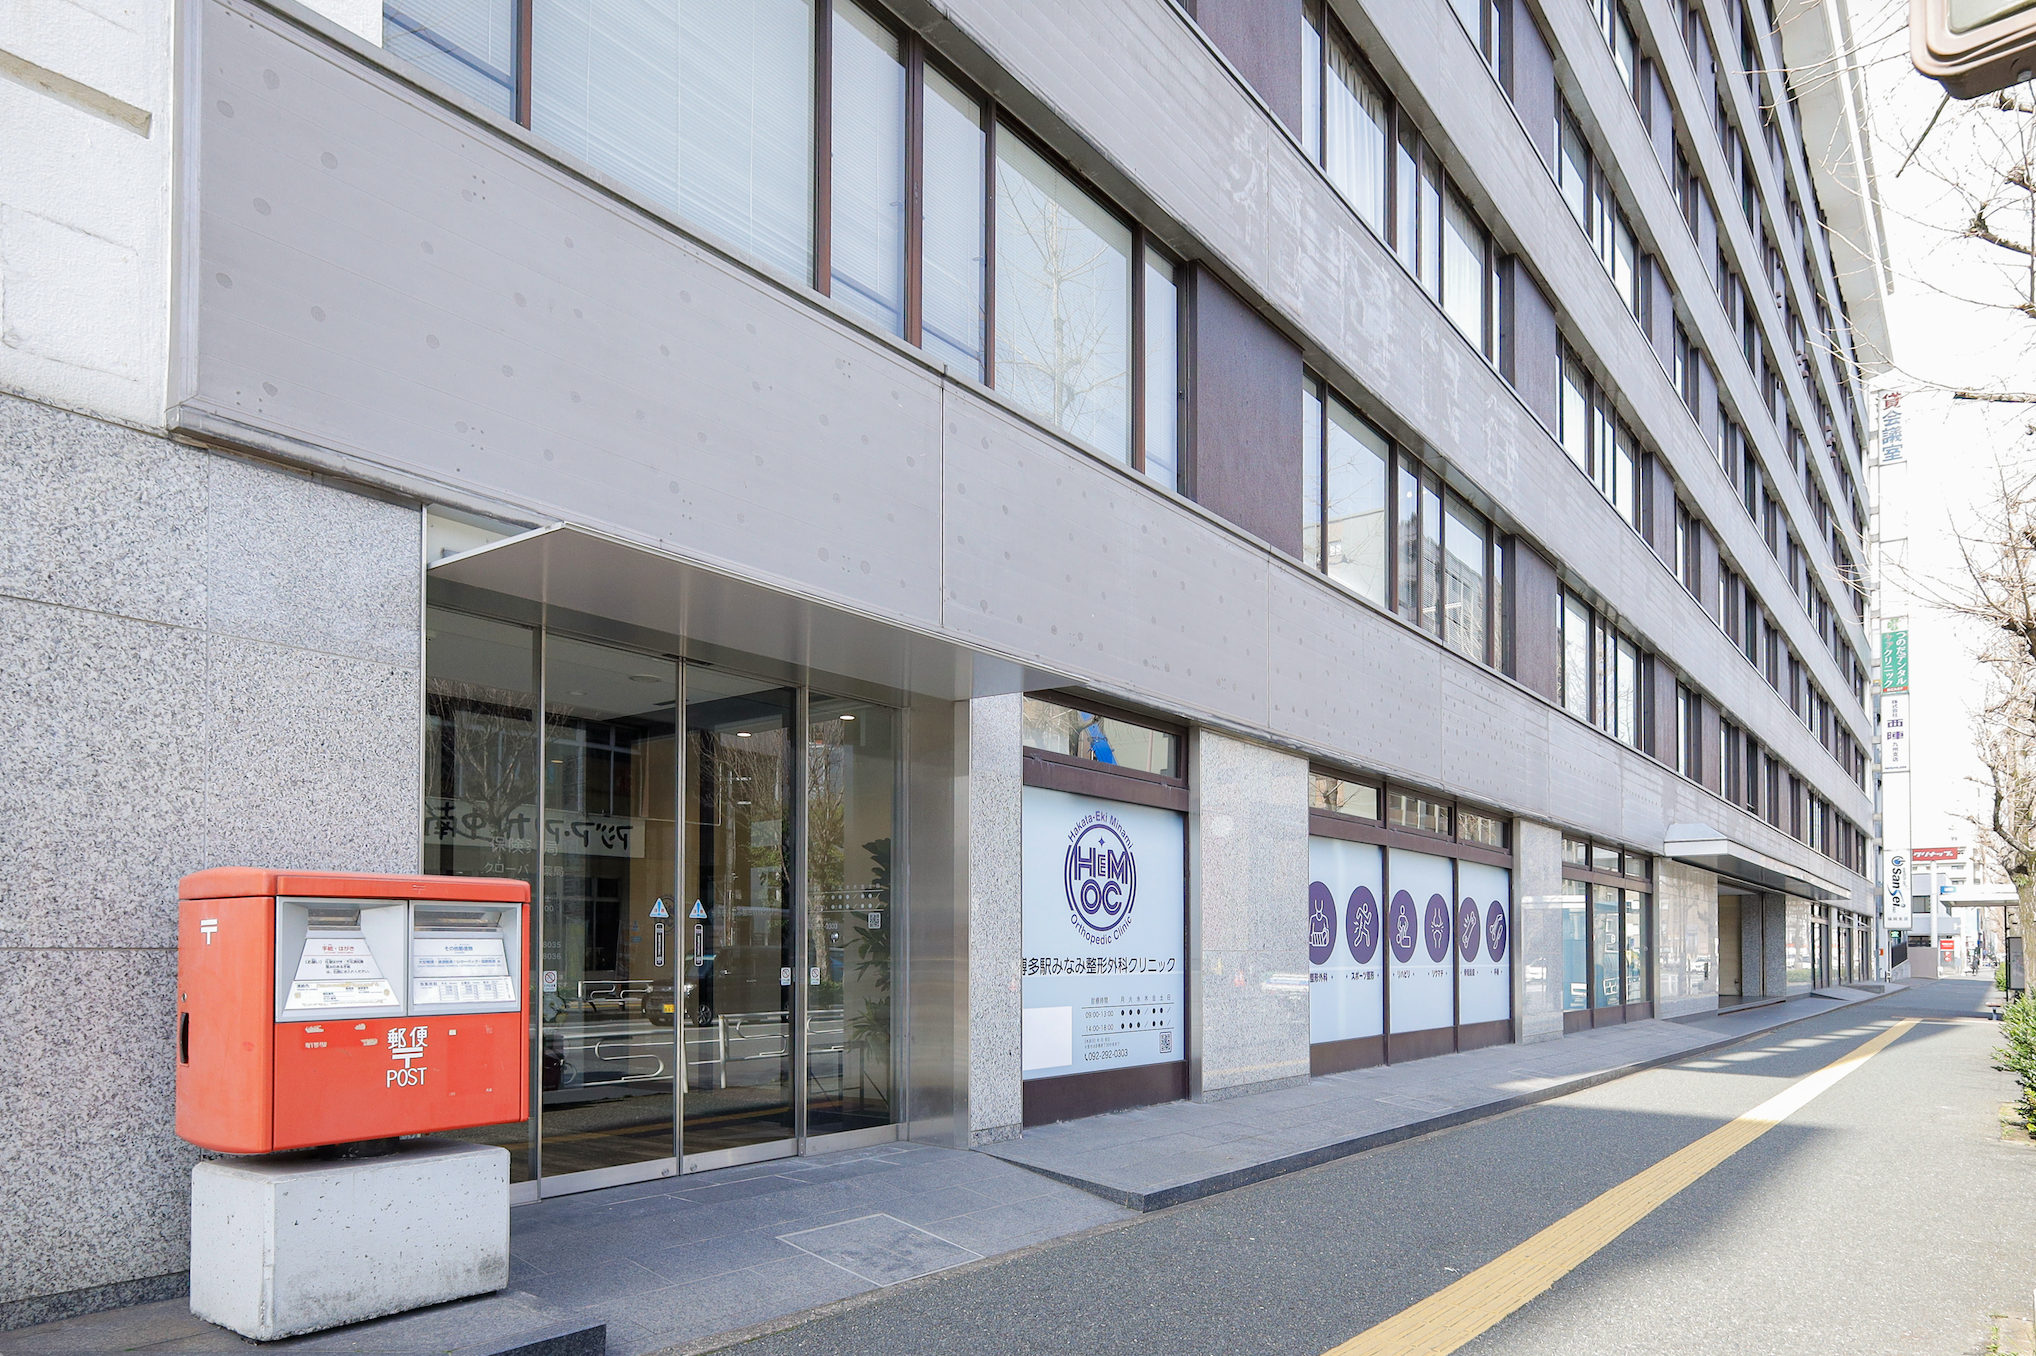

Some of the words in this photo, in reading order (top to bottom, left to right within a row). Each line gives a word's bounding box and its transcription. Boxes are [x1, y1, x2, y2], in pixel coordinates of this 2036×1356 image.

[1882, 391, 1904, 462] 貸会議室
[1883, 634, 1894, 688] ケアクリニック
[1895, 632, 1909, 686] つのだデンタル
[1068, 810, 1108, 843] Hakata-Eki
[1110, 814, 1134, 849] Minami
[1080, 878, 1123, 916] OC
[1070, 912, 1112, 946] Orthopedic
[1113, 916, 1133, 941] Clinic
[1351, 971, 1375, 980] スポーツ整形
[1085, 1010, 1114, 1019] 09:00-13:00
[387, 1026, 429, 1050] 郵便
[1088, 1048, 1128, 1061] 092-292-0303
[386, 1067, 428, 1088] POST
